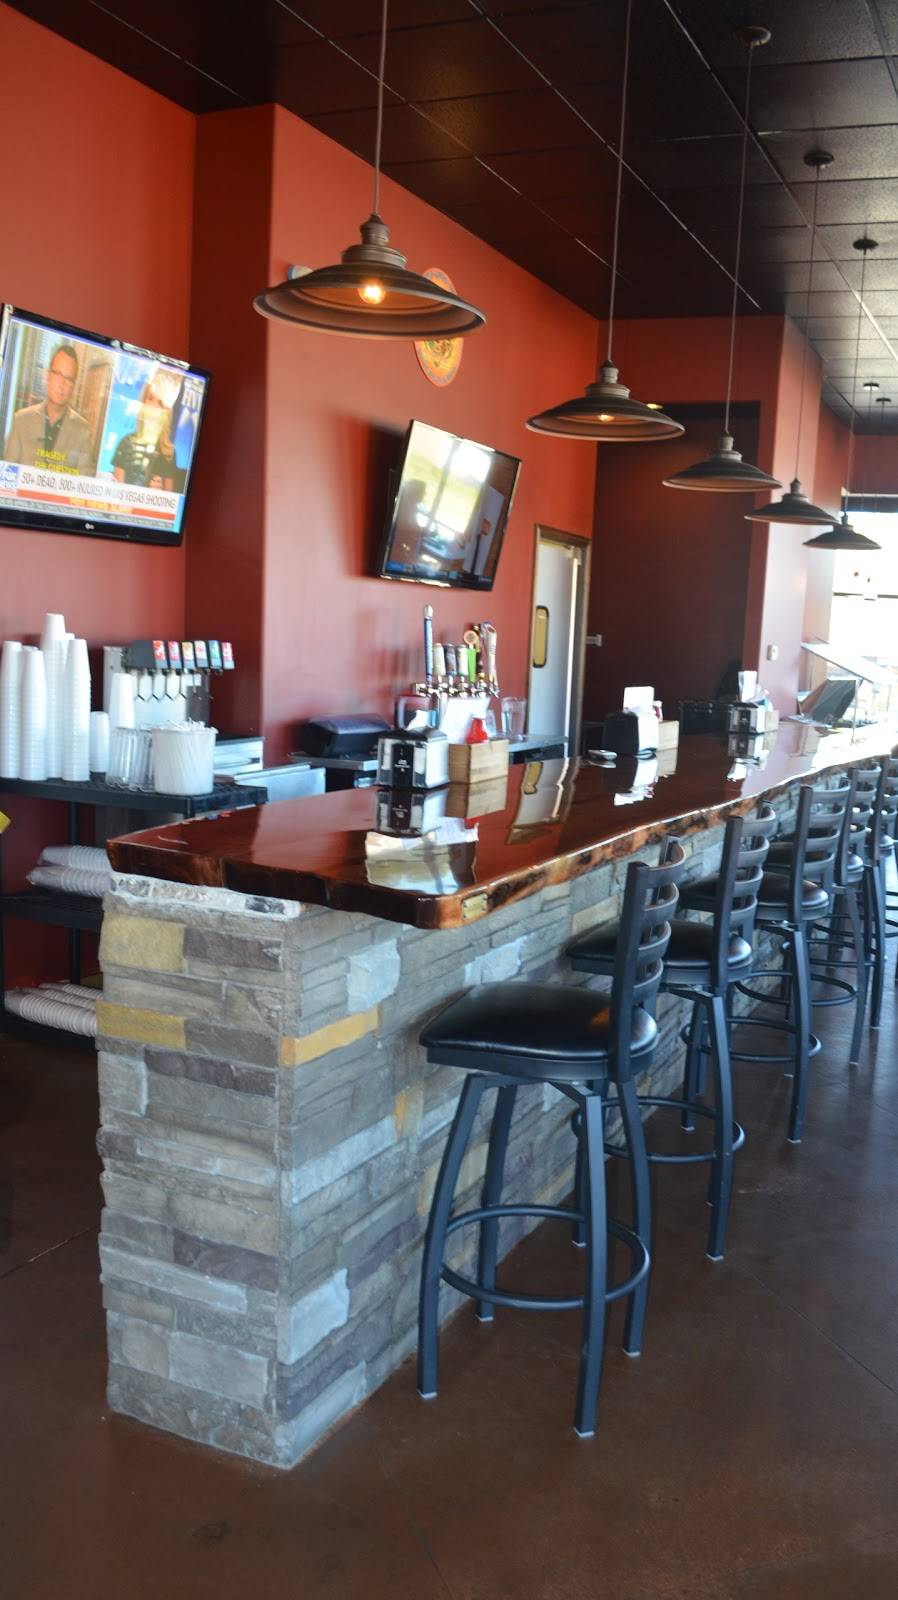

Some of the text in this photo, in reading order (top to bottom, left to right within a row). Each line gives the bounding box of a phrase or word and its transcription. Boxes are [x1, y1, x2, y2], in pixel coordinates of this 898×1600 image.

[22, 472, 35, 484] 50+
[59, 478, 76, 491] 500+
[78, 481, 103, 496] INJURED
[124, 490, 144, 504] VEGAS
[145, 494, 176, 510] SHOOTING
